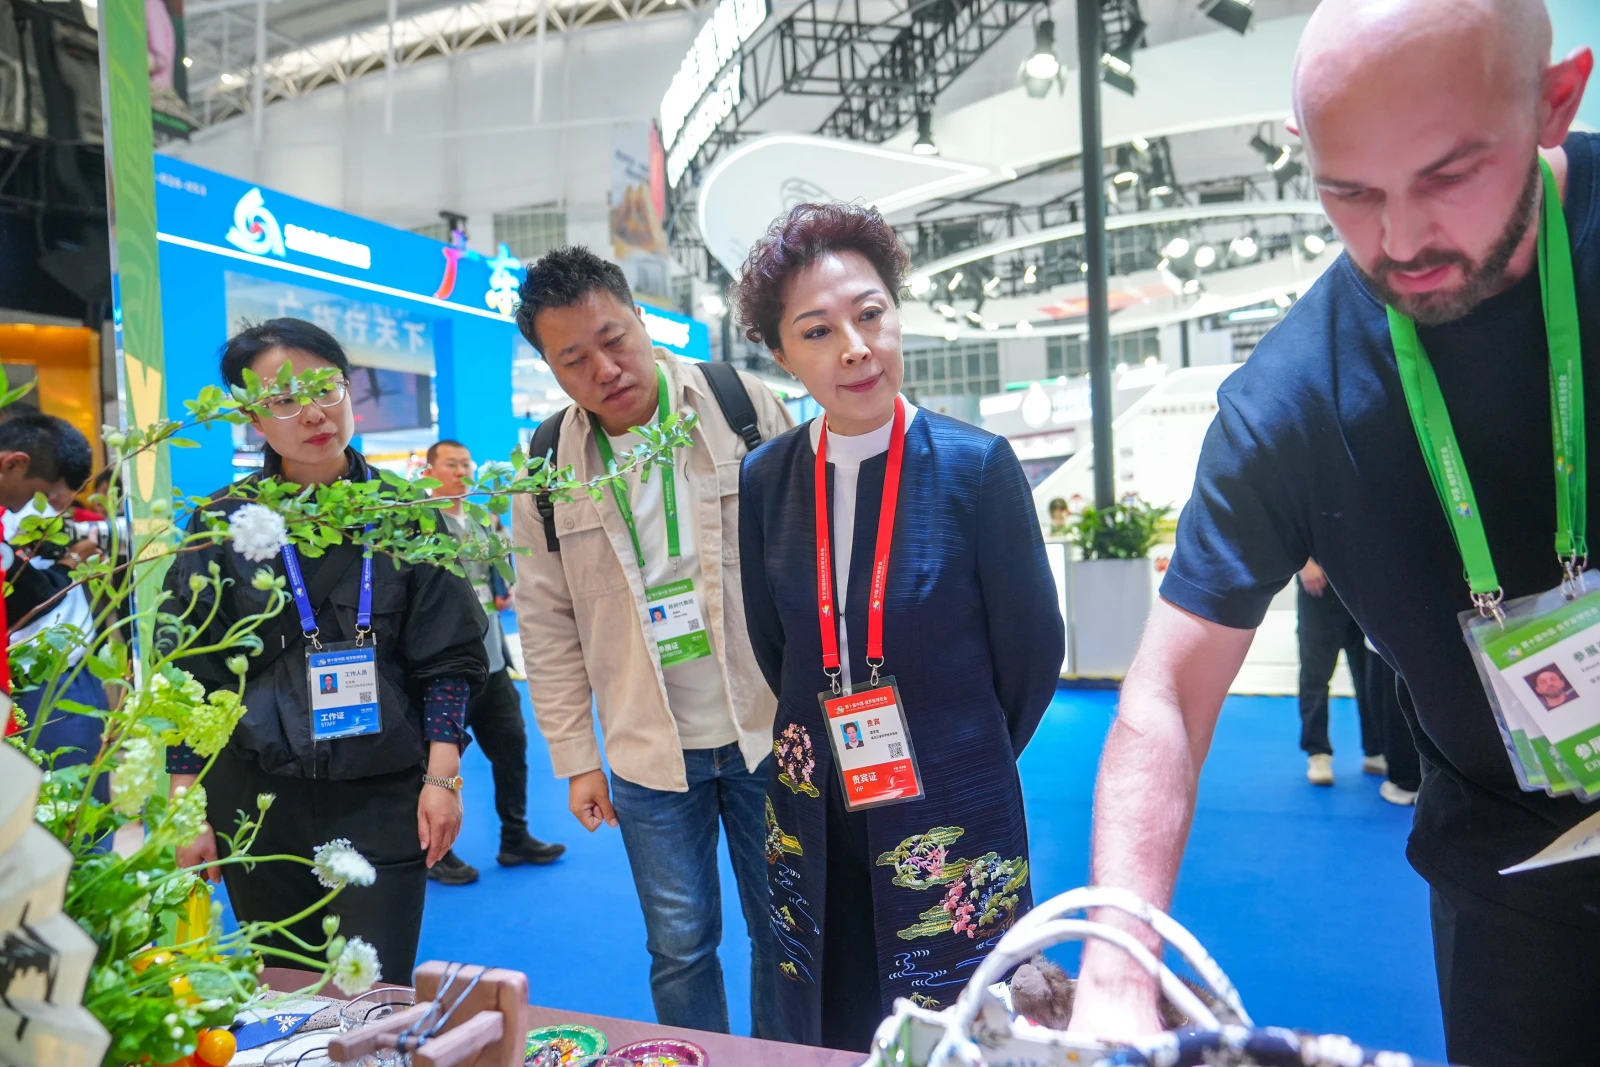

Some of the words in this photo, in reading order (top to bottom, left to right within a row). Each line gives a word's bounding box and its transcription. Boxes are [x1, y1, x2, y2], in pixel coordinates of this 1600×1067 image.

[1573, 641, 1600, 662] 参展
[344, 669, 368, 678] 工作人员
[320, 711, 345, 722] 工作证
[866, 718, 881, 728] 贵宾
[851, 771, 878, 785] 贵宾证
[854, 785, 864, 793] VIP
